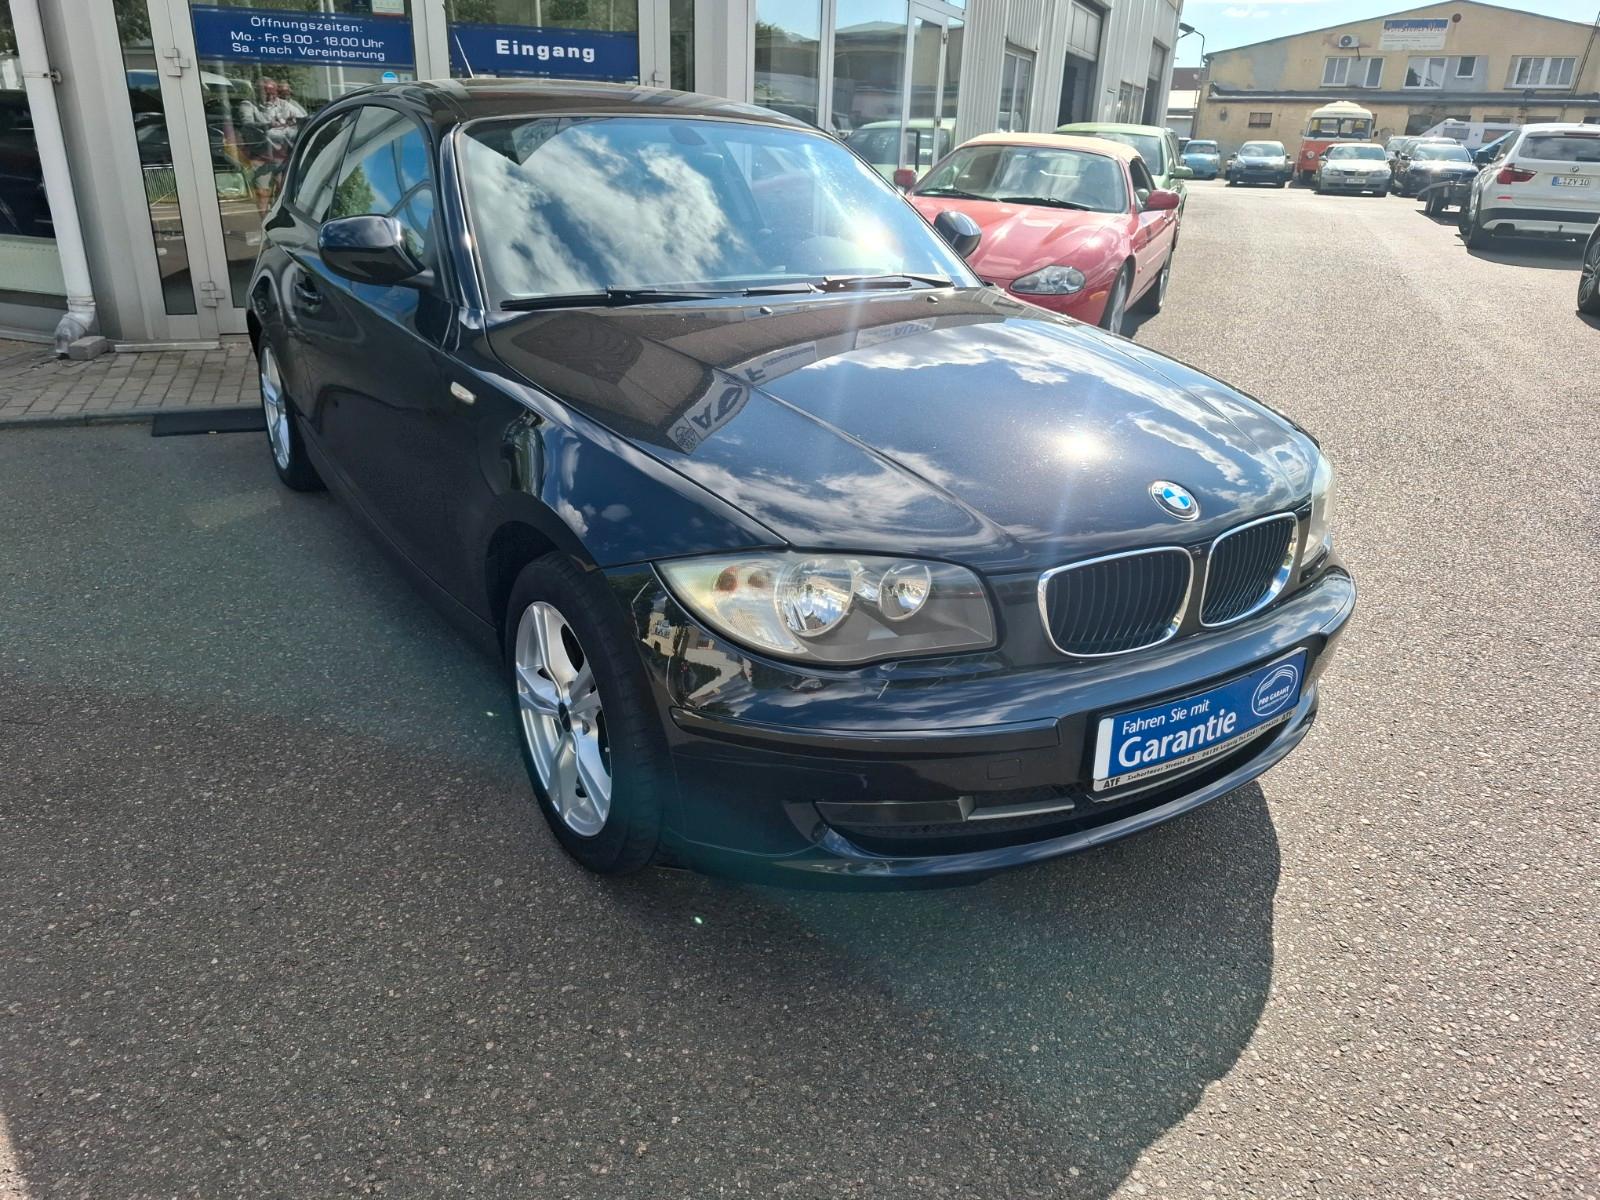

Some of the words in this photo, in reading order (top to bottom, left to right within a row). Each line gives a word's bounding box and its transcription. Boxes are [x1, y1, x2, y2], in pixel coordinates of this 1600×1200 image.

[250, 15, 364, 33] Öffnungszeiten:
[230, 30, 255, 42] Mo.
[264, 33, 280, 43] Fr.
[282, 34, 313, 45] 9.00
[323, 36, 359, 47] 18.00
[361, 38, 385, 49] Uhr
[231, 42, 254, 53] Sa.
[260, 45, 292, 55] nach
[298, 46, 385, 61] Vereinbarung
[495, 39, 595, 63] Eingang
[1122, 714, 1166, 736] Fahren
[1169, 707, 1188, 722] Sie
[1190, 699, 1210, 717] mit
[1118, 708, 1237, 768] Garantie
[1103, 776, 1121, 789] ATF
